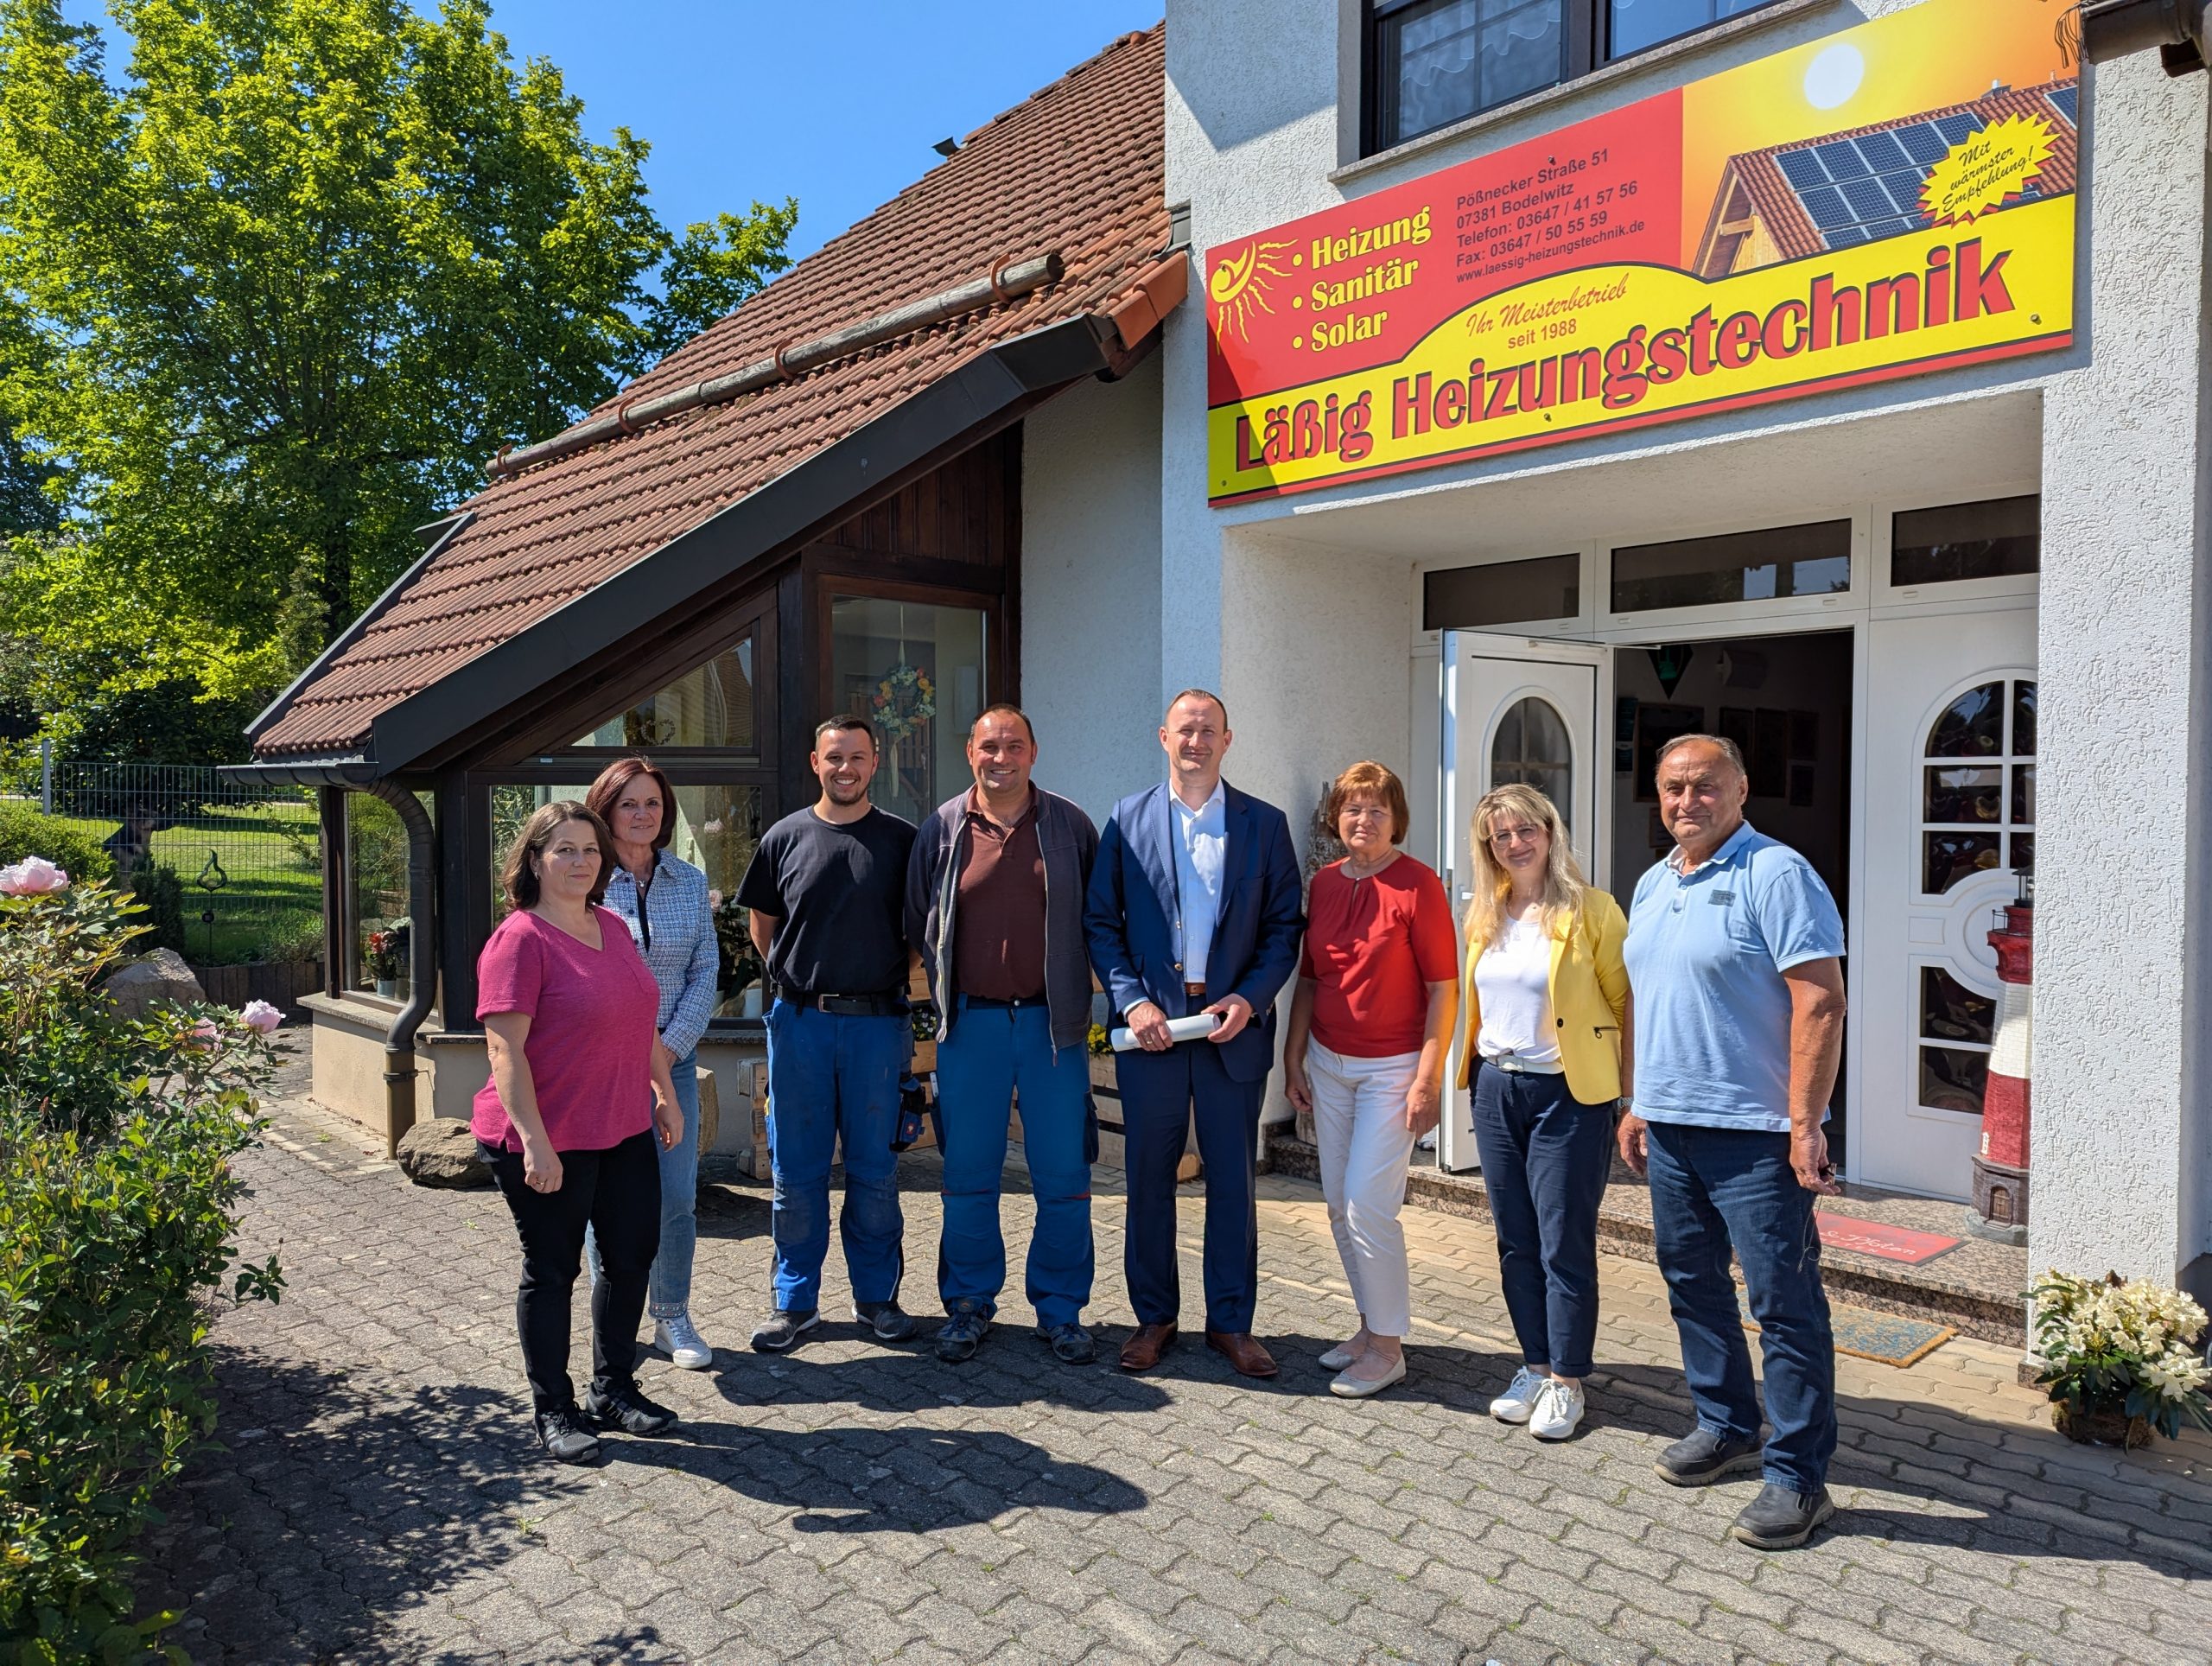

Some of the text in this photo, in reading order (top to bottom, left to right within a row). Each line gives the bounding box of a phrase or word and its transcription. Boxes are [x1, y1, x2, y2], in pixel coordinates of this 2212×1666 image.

[1457, 148, 1609, 210] Pößnecker Straße 51
[1942, 144, 2034, 213] Empfehlung!
[1950, 147, 2015, 190] wärmster
[1958, 141, 1992, 167] Mit
[1456, 182, 1574, 229] 07381 Bodelwitz
[1457, 221, 1512, 248] Telefon:
[1516, 206, 1559, 230] 03647
[1573, 195, 1591, 213] 41
[1596, 188, 1614, 206] 57
[1619, 180, 1637, 198] 56
[1312, 205, 1433, 269] Heizung
[1456, 220, 1645, 283] www.laessig-heizungstechnik.de
[1457, 250, 1485, 267] Fax:
[1490, 233, 1532, 258] 03647
[1545, 225, 1562, 241] 50
[1567, 218, 1585, 235] 55
[1589, 210, 1607, 228] 59
[1311, 257, 1419, 312] Sanitär
[1465, 272, 1630, 337] Ihr Meisterbetrieb
[1236, 236, 2015, 472] Läßig Heizungstechnik
[1311, 308, 1389, 352] Solar
[1507, 318, 1577, 349] seit 1988
